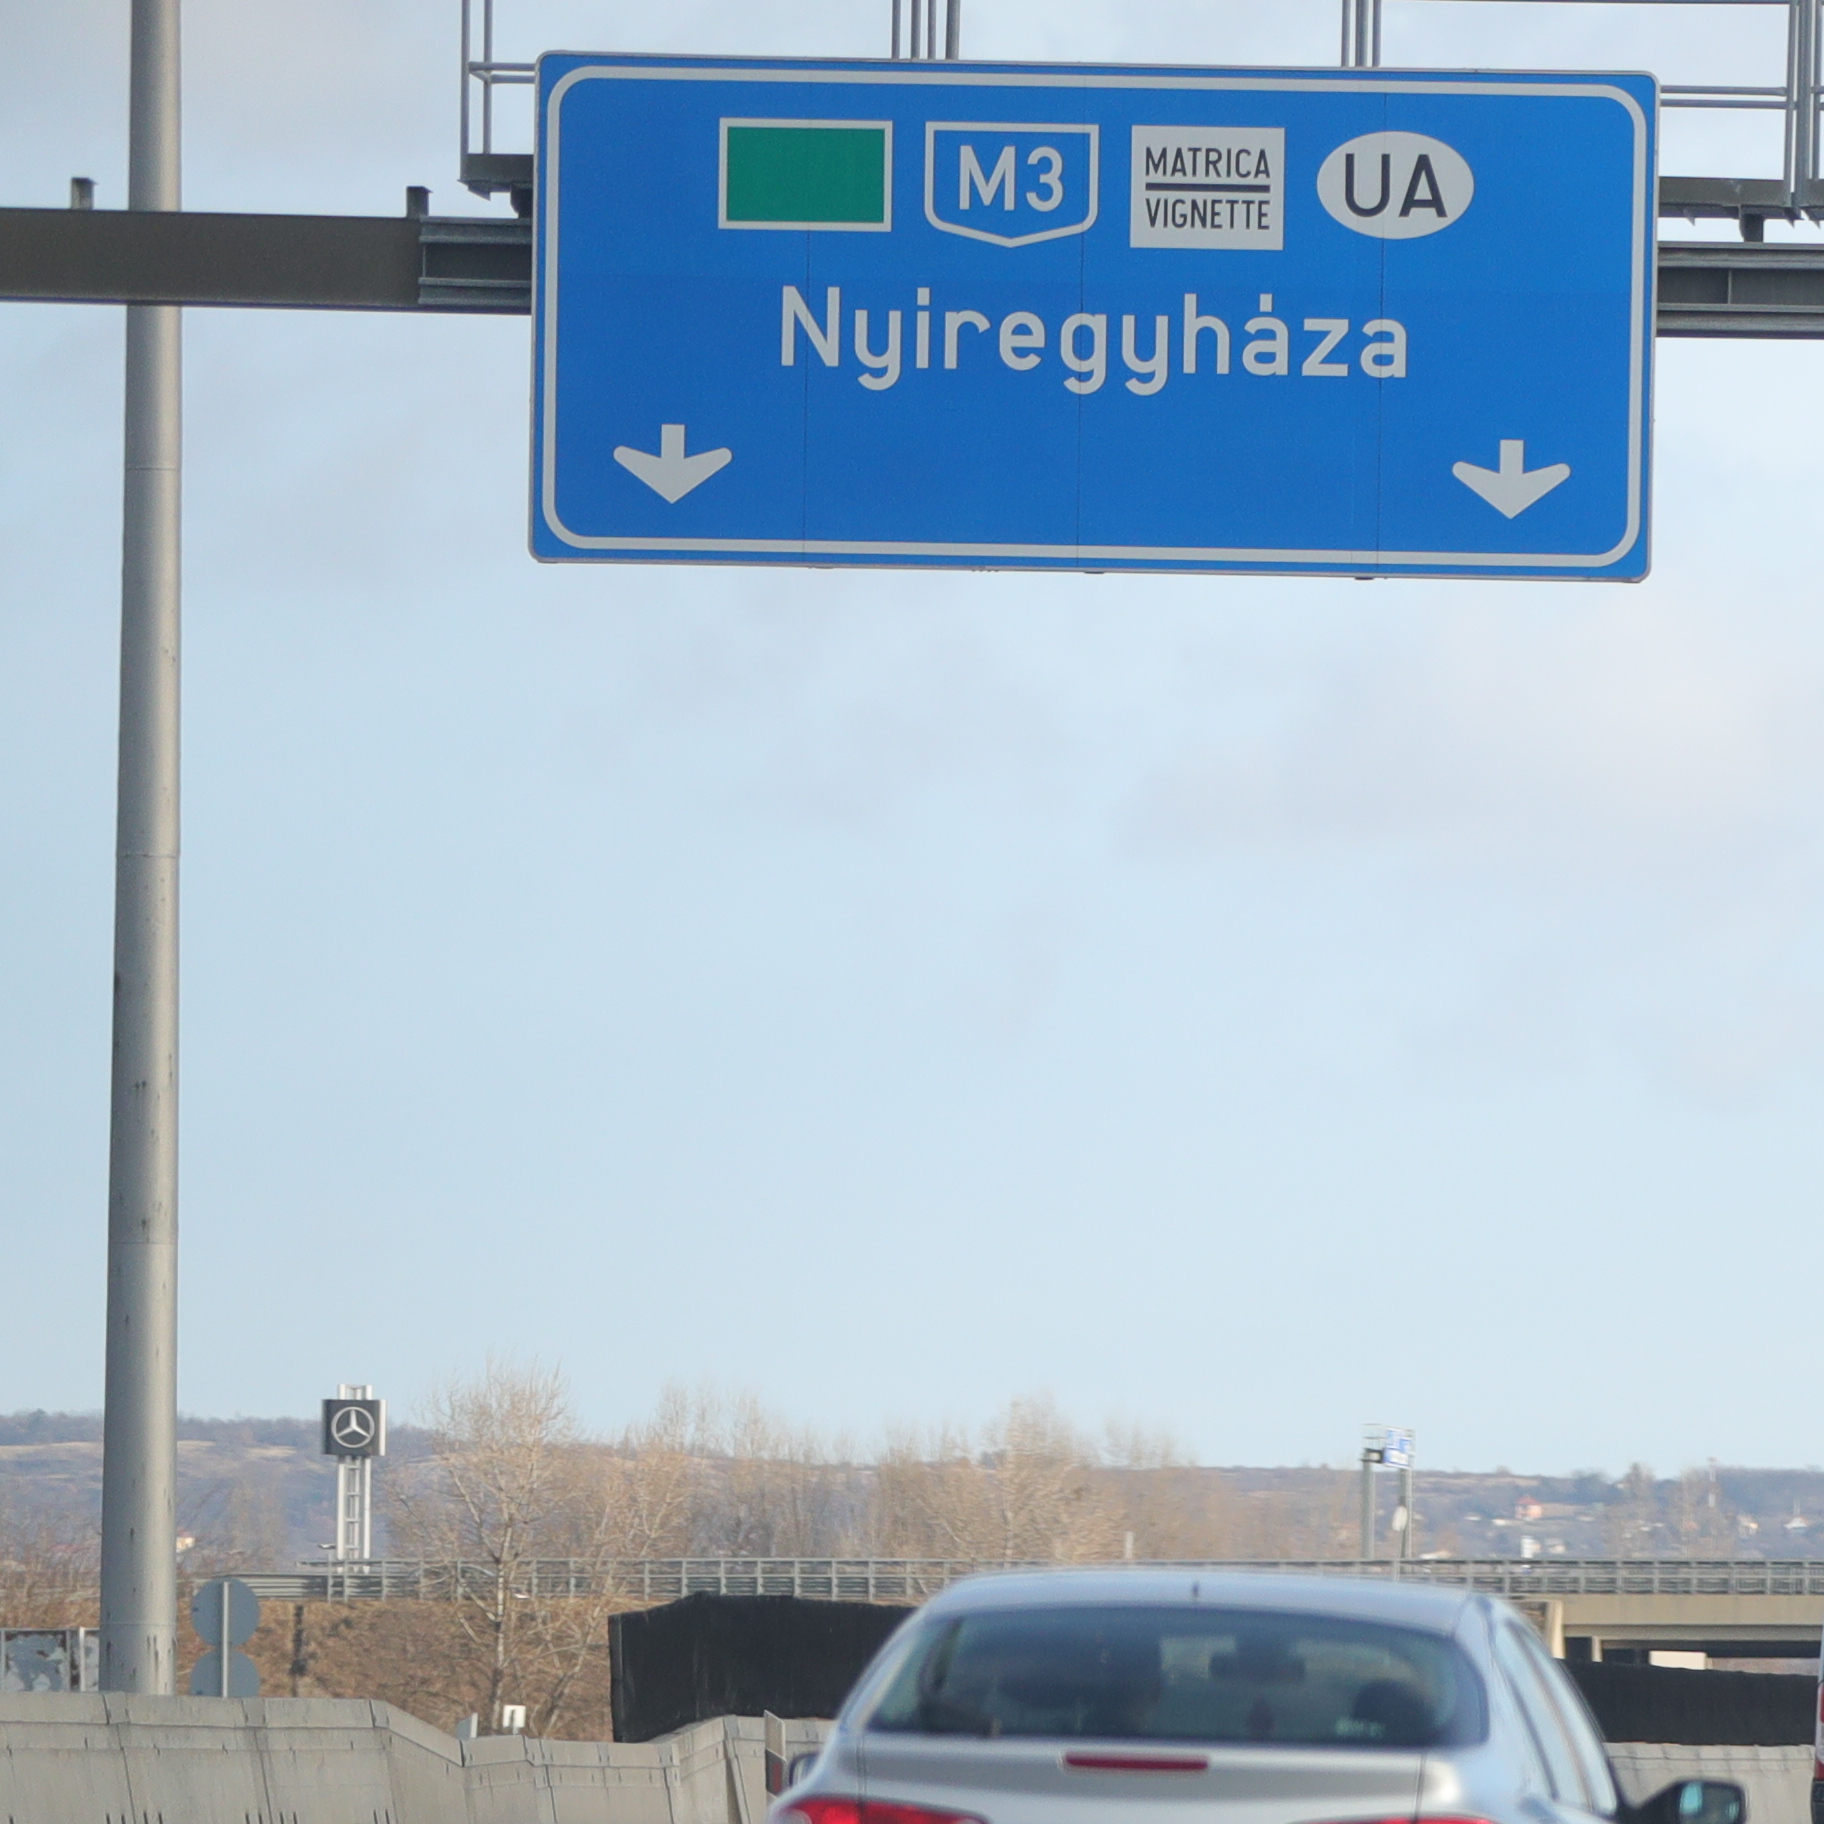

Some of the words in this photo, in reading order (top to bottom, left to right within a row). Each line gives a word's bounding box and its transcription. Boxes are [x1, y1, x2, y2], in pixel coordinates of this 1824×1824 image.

[957, 145, 1065, 212] M3
[1144, 146, 1272, 181] MATRICA
[1345, 153, 1448, 218] UA
[1144, 197, 1272, 232] VIGNETTE
